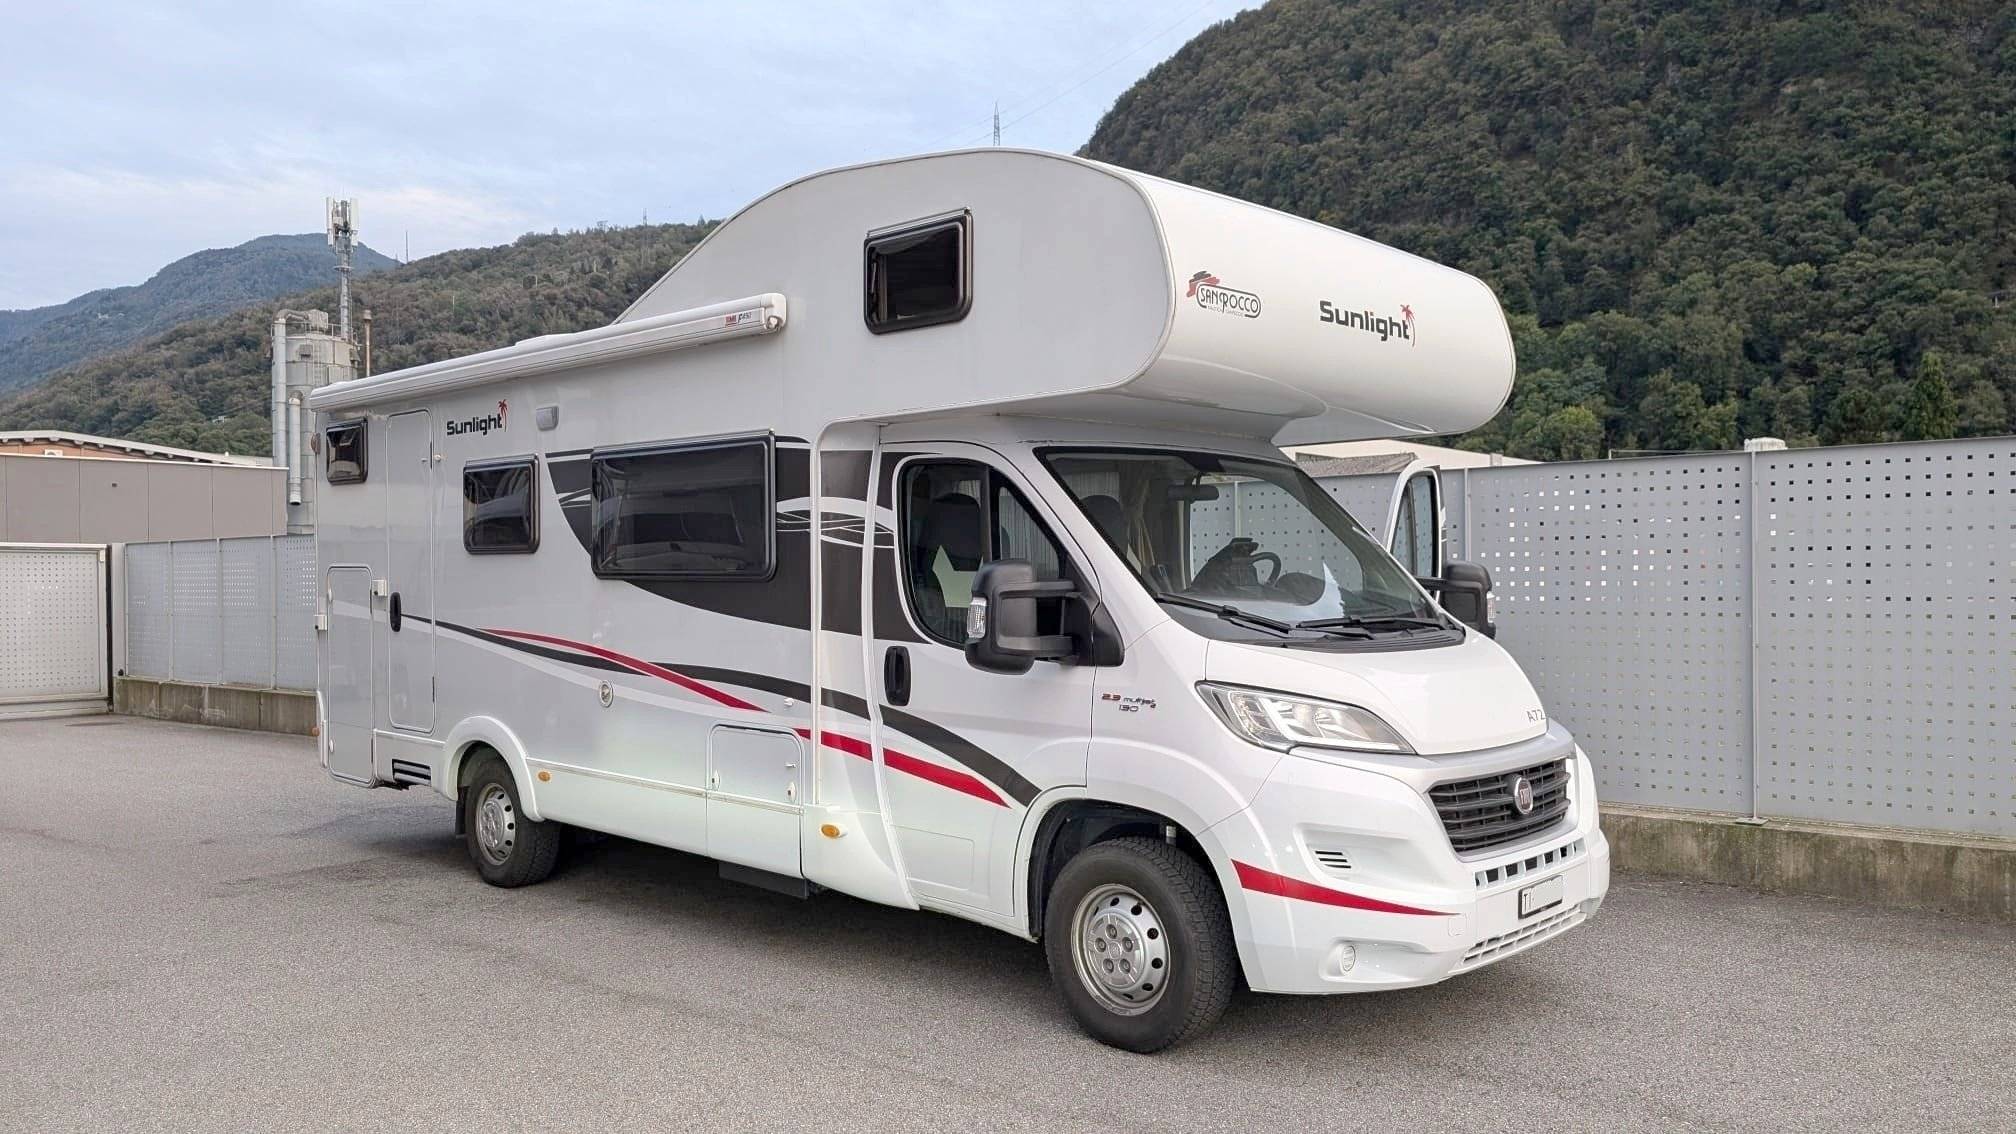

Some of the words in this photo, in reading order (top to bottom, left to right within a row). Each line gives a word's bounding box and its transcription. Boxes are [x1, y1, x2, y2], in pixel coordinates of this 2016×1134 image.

[1319, 300, 1410, 342] Sunlight
[446, 413, 503, 436] Sunlight
[1119, 704, 1139, 712] 130
[1526, 709, 1547, 723] A72
